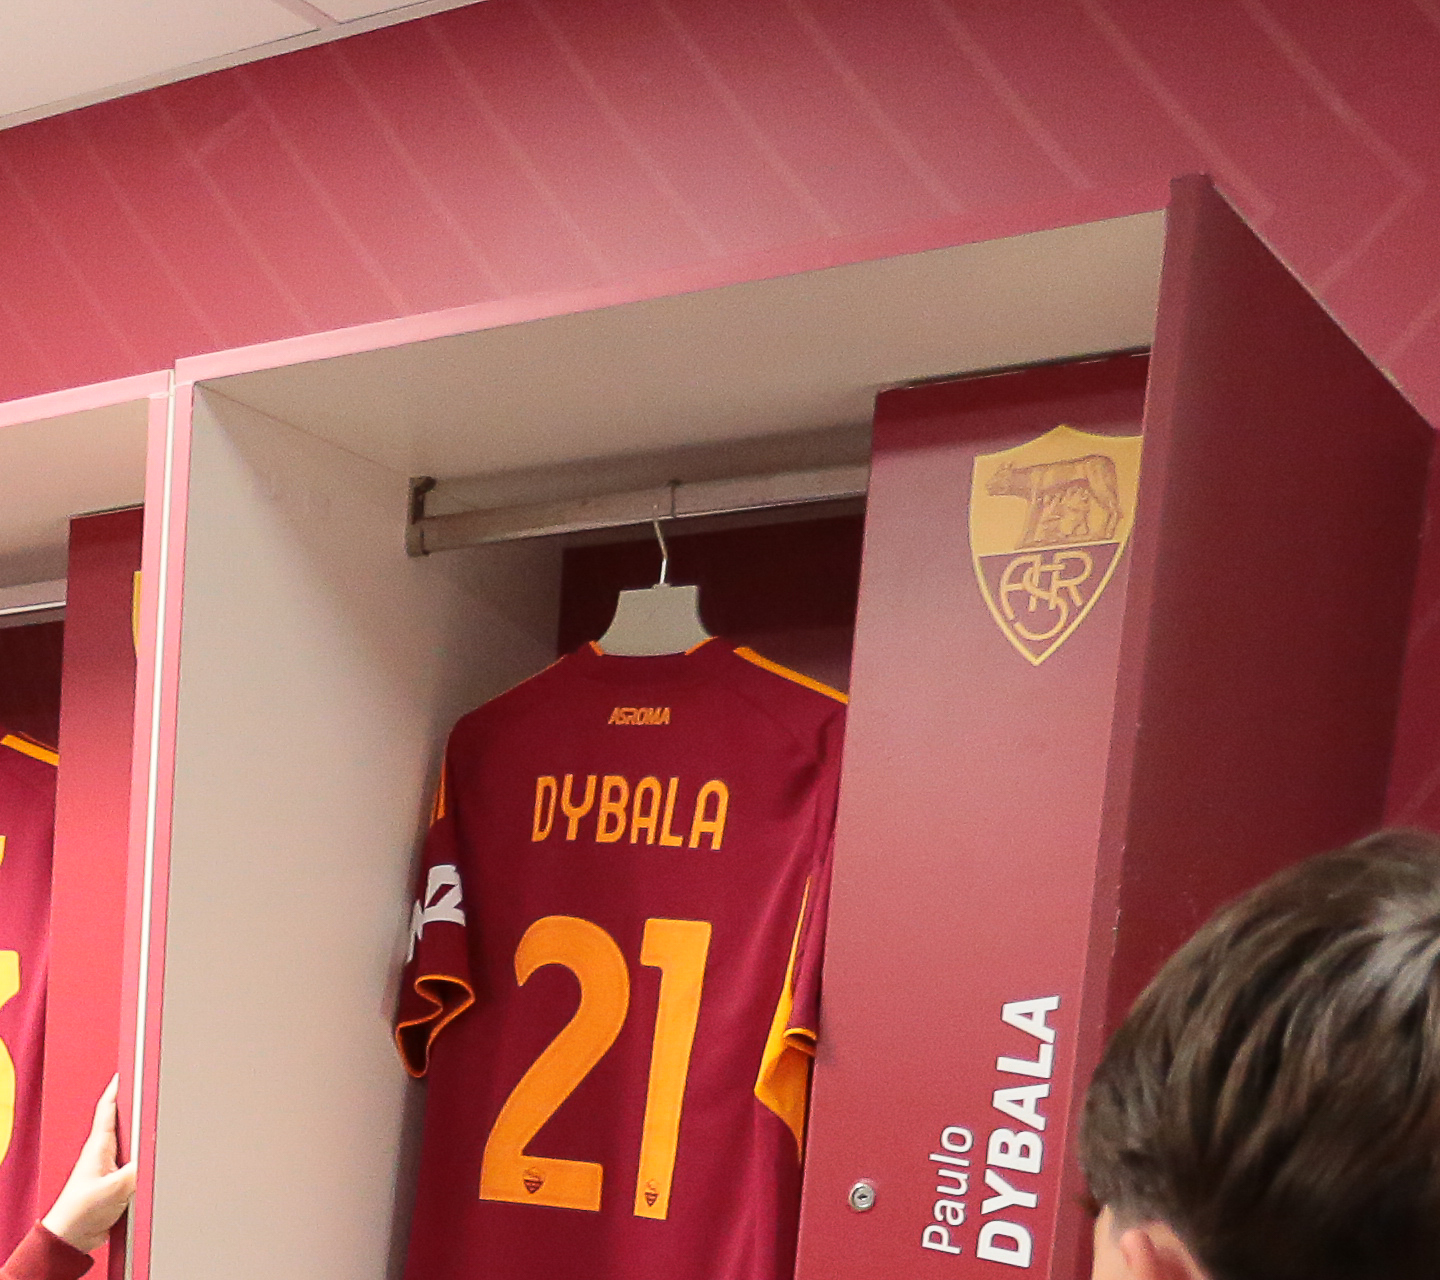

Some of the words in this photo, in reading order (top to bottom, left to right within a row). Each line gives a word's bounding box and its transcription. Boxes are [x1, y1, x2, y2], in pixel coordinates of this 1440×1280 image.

[531, 774, 729, 850] DYBALA
[479, 915, 712, 1221] 21
[976, 995, 1060, 1268] DYBALA
[921, 1124, 976, 1255] Paulo
